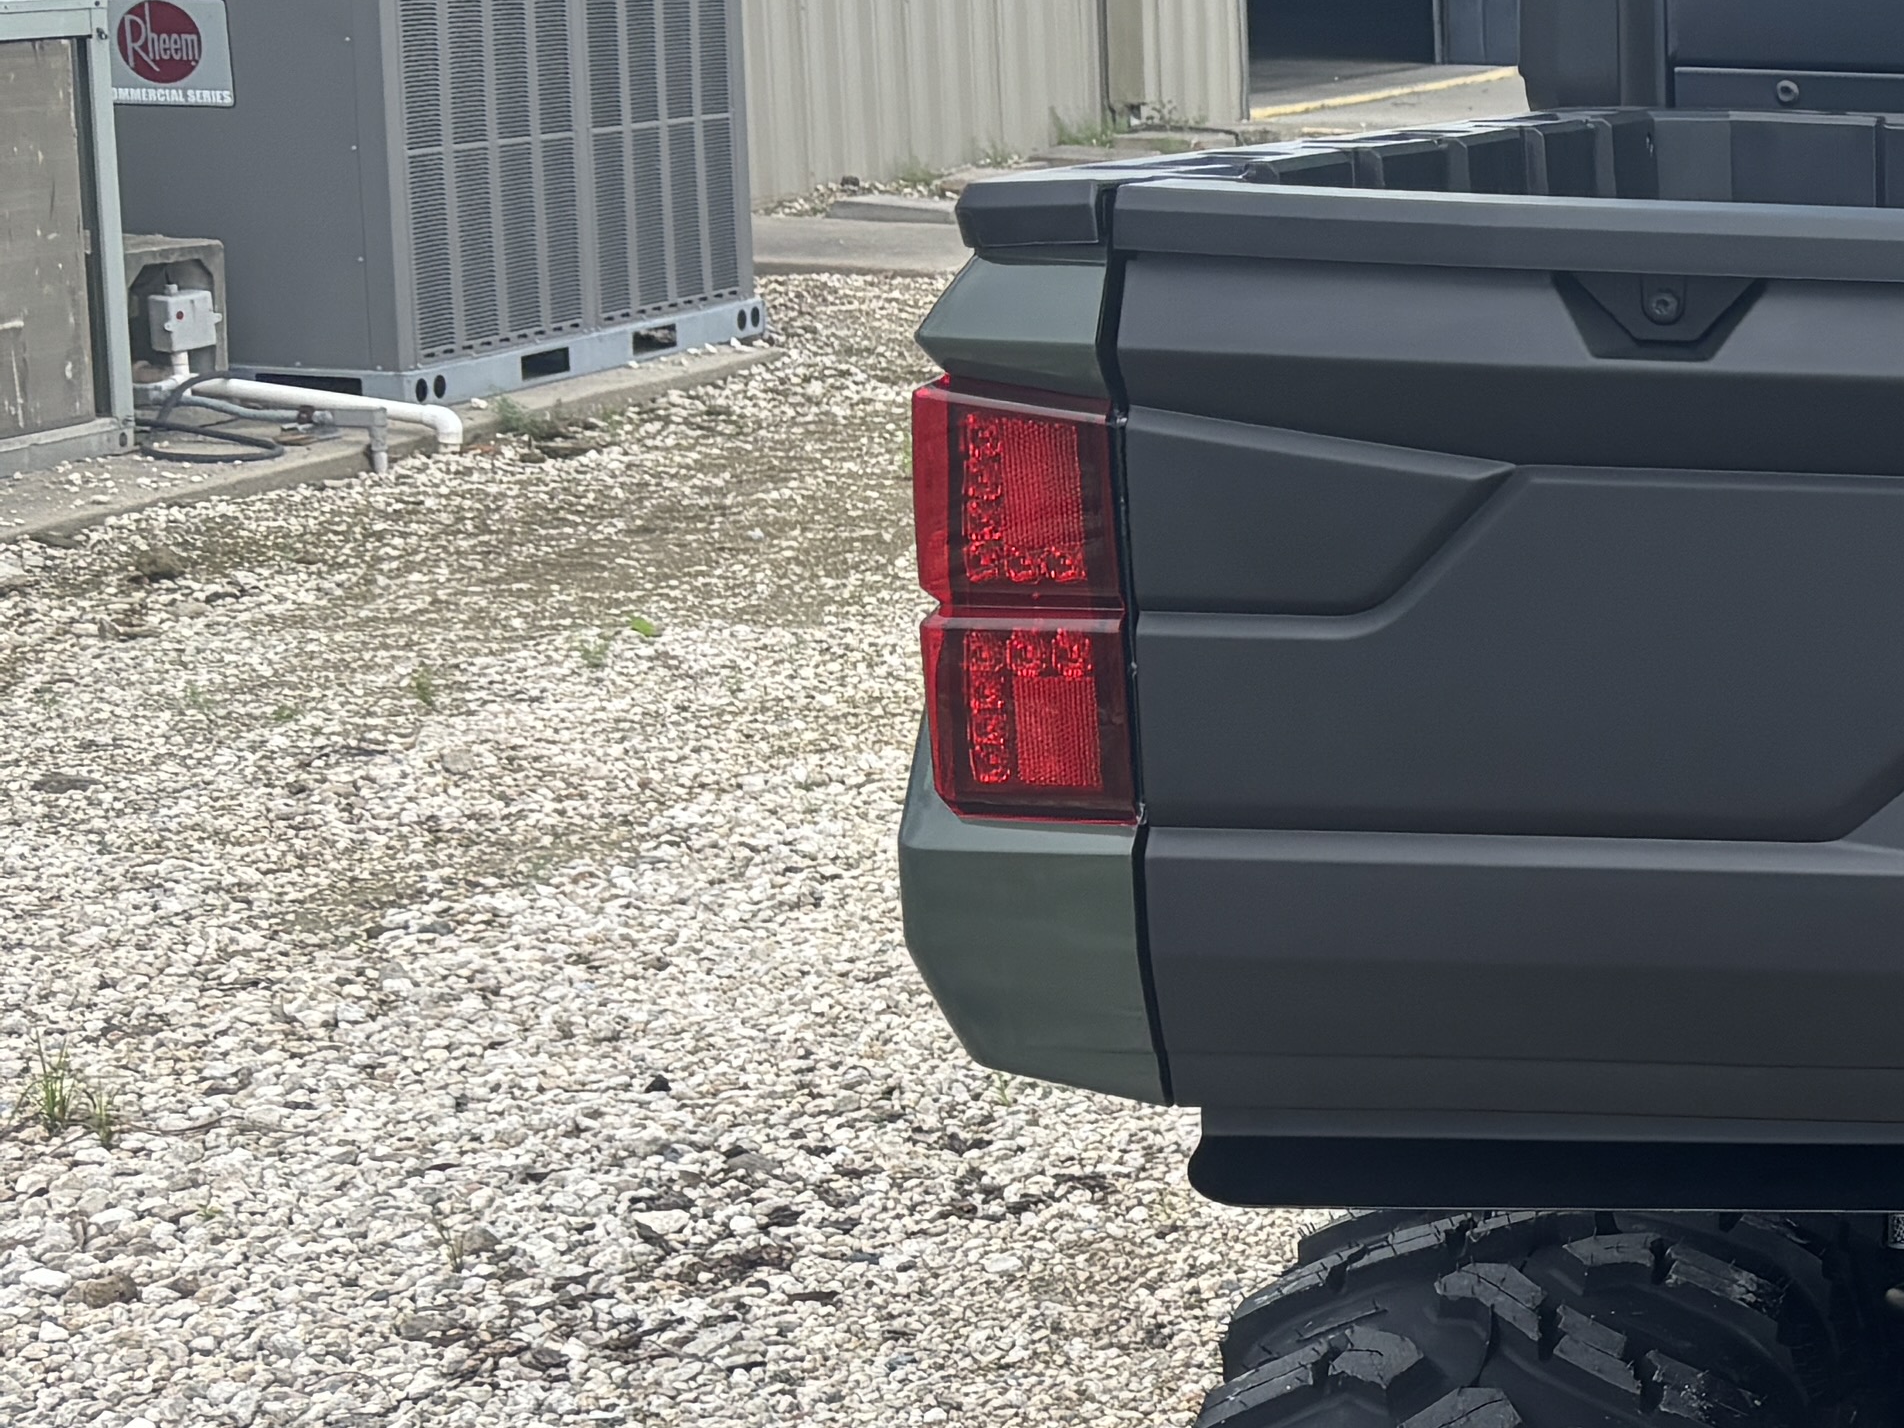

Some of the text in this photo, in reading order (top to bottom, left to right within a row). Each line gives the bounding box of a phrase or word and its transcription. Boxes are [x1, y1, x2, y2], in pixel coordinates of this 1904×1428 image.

[123, 2, 199, 72] Rheem
[112, 87, 232, 103] OMMERCIAL SERIES
